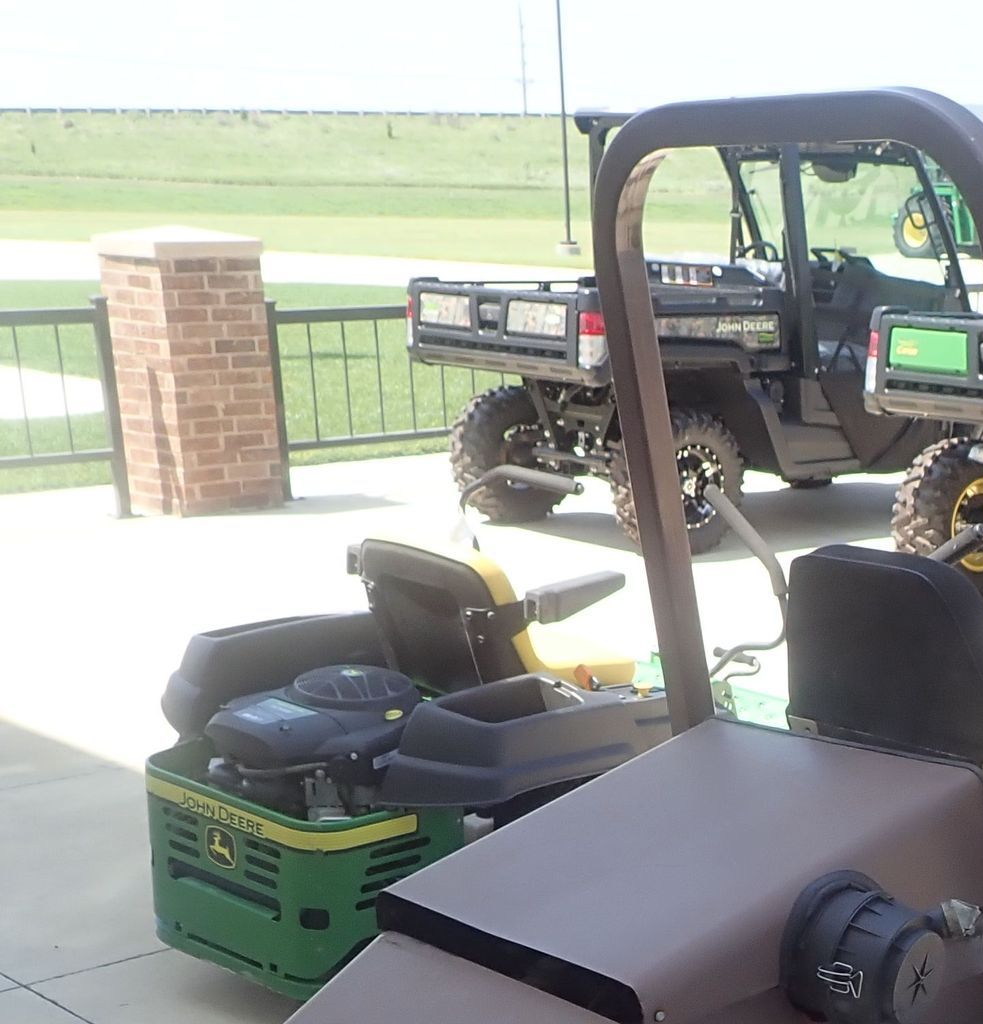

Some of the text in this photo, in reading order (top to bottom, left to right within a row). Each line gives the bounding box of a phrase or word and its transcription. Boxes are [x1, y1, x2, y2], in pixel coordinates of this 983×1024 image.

[716, 320, 775, 333] JOHN DEERE
[180, 792, 264, 837] JOHN DEERE
